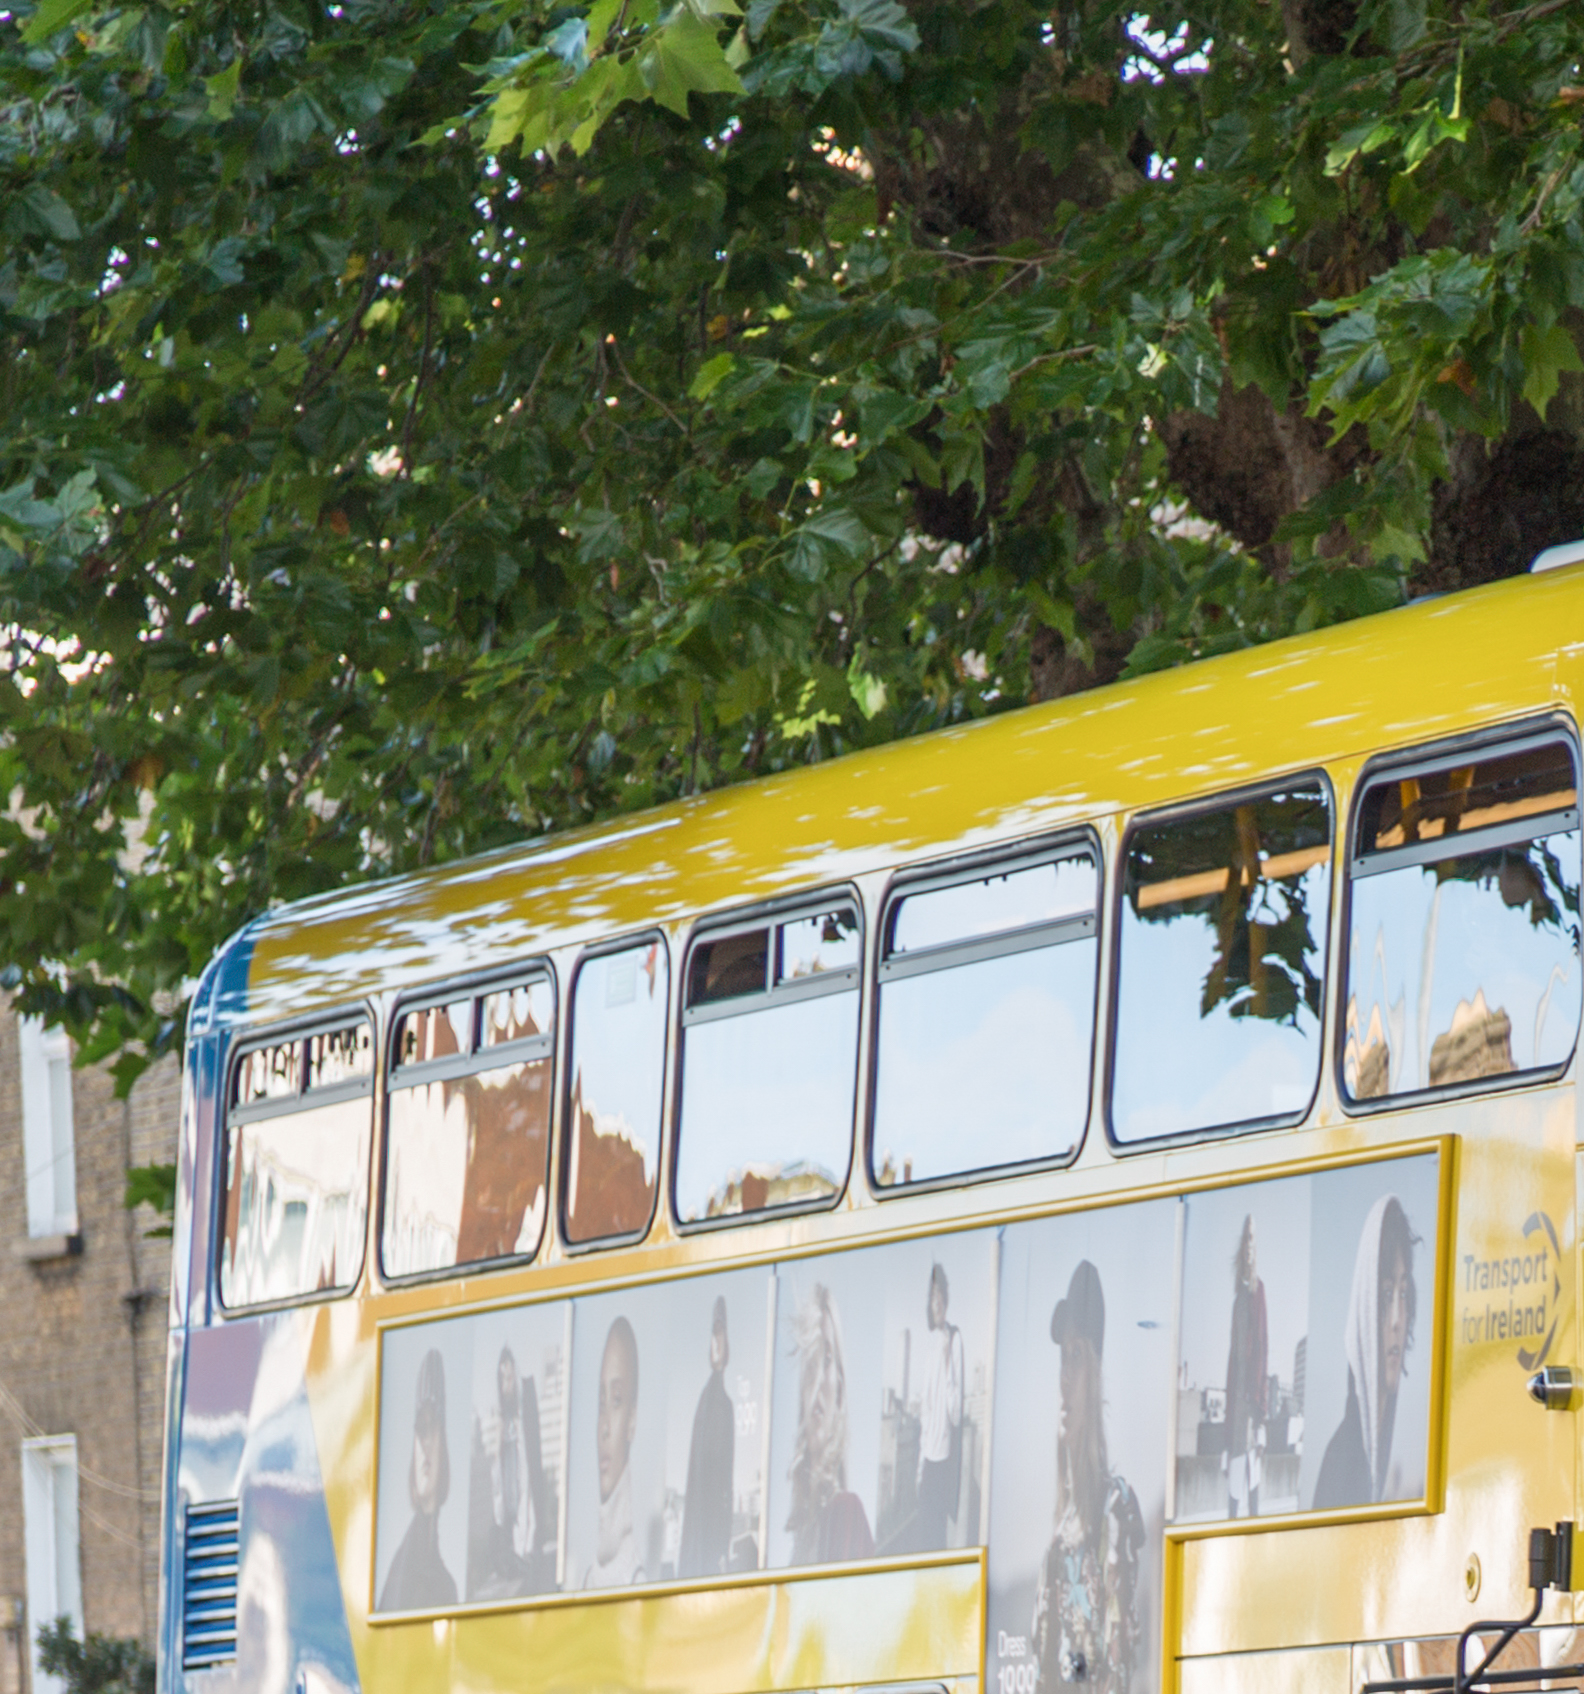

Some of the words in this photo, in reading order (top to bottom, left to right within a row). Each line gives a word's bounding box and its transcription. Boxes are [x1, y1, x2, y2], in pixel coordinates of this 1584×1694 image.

[1463, 1246, 1548, 1294] Transport
[1462, 1307, 1482, 1344] for
[1485, 1295, 1546, 1341] Ireland
[997, 1630, 1027, 1658] Dress
